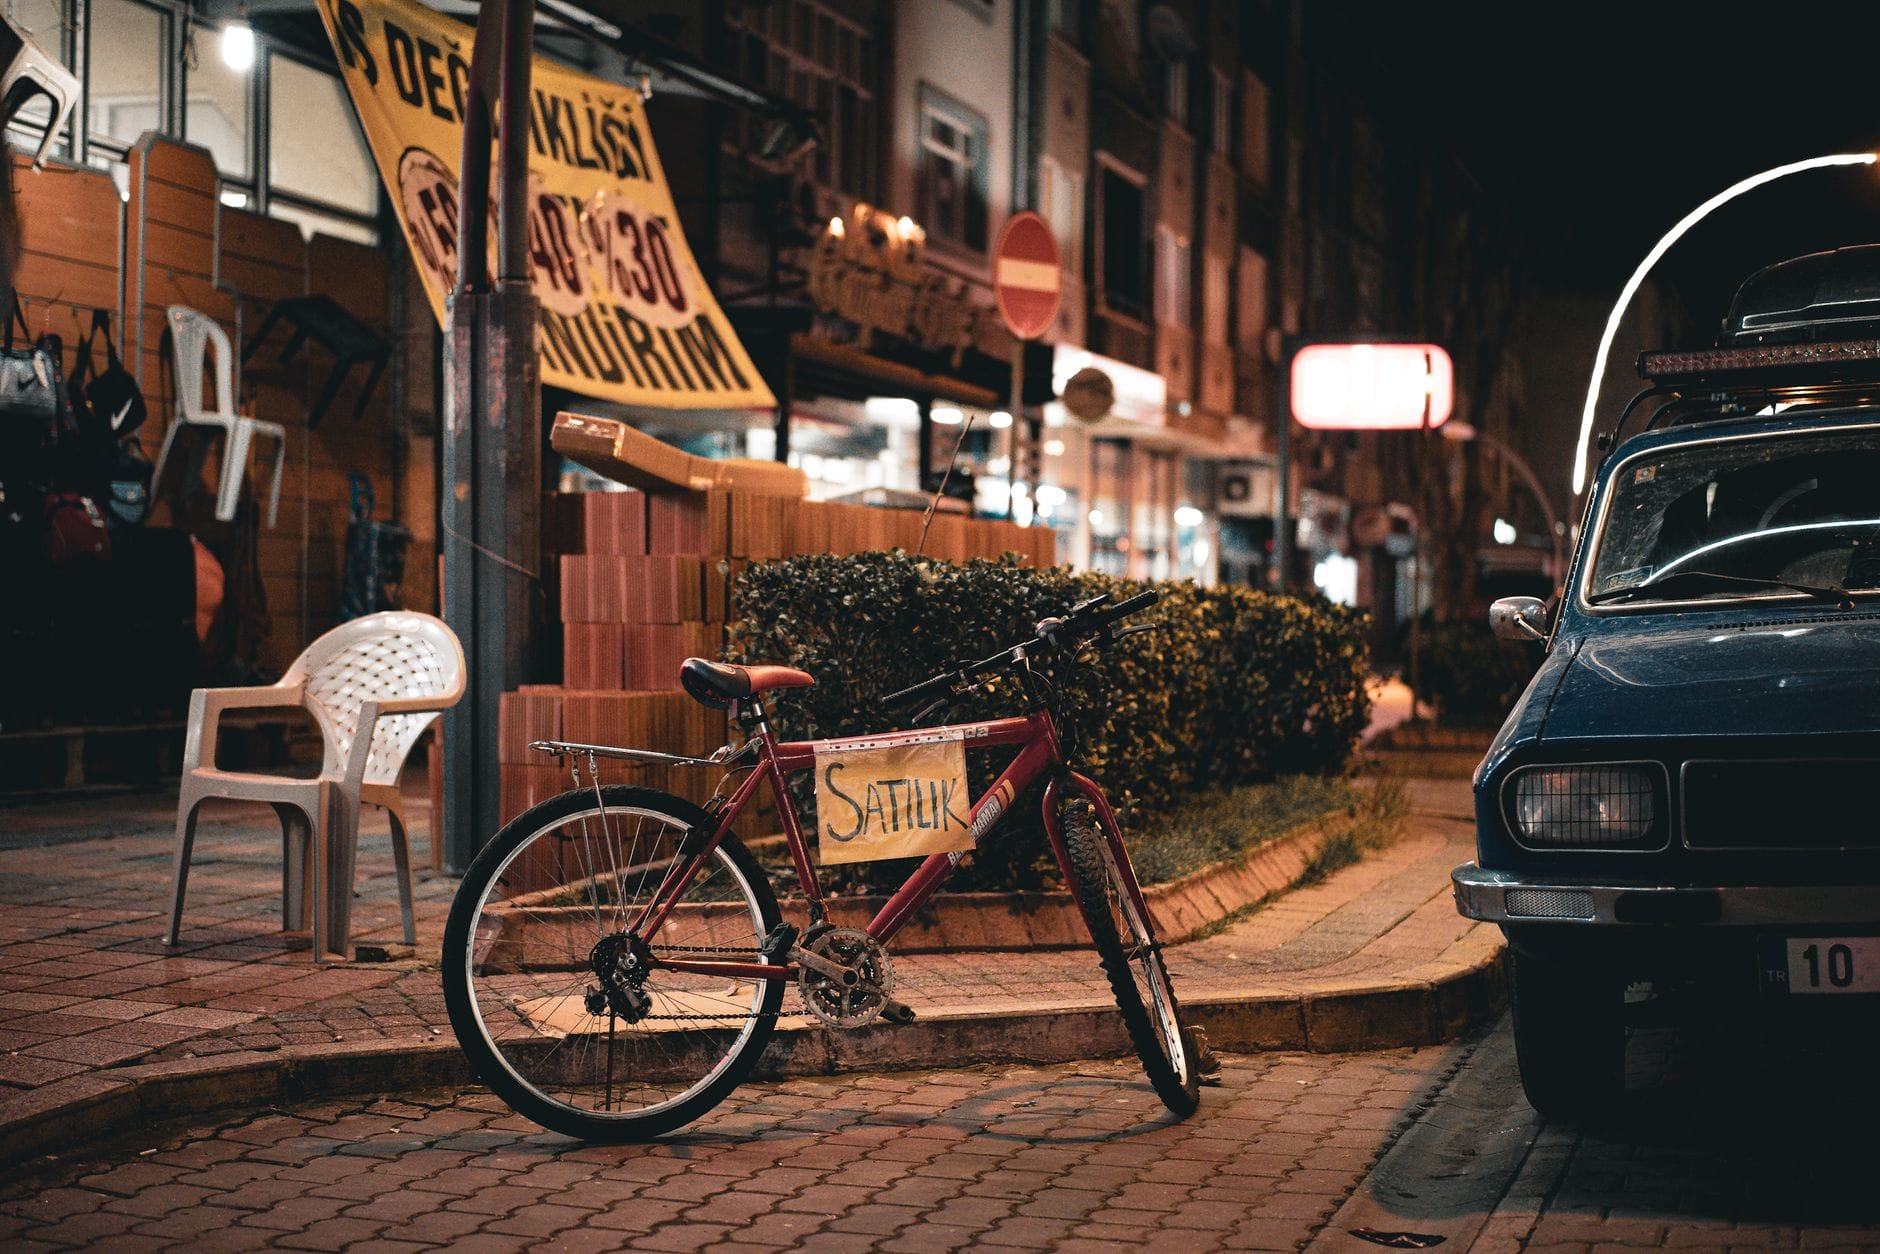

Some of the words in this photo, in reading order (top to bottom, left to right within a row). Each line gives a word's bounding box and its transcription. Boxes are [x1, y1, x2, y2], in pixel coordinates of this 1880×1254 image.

[587, 210, 687, 312] %30
[825, 761, 969, 842] SATILIK
[1766, 970, 1786, 982] TR
[1803, 943, 1853, 988] 10
